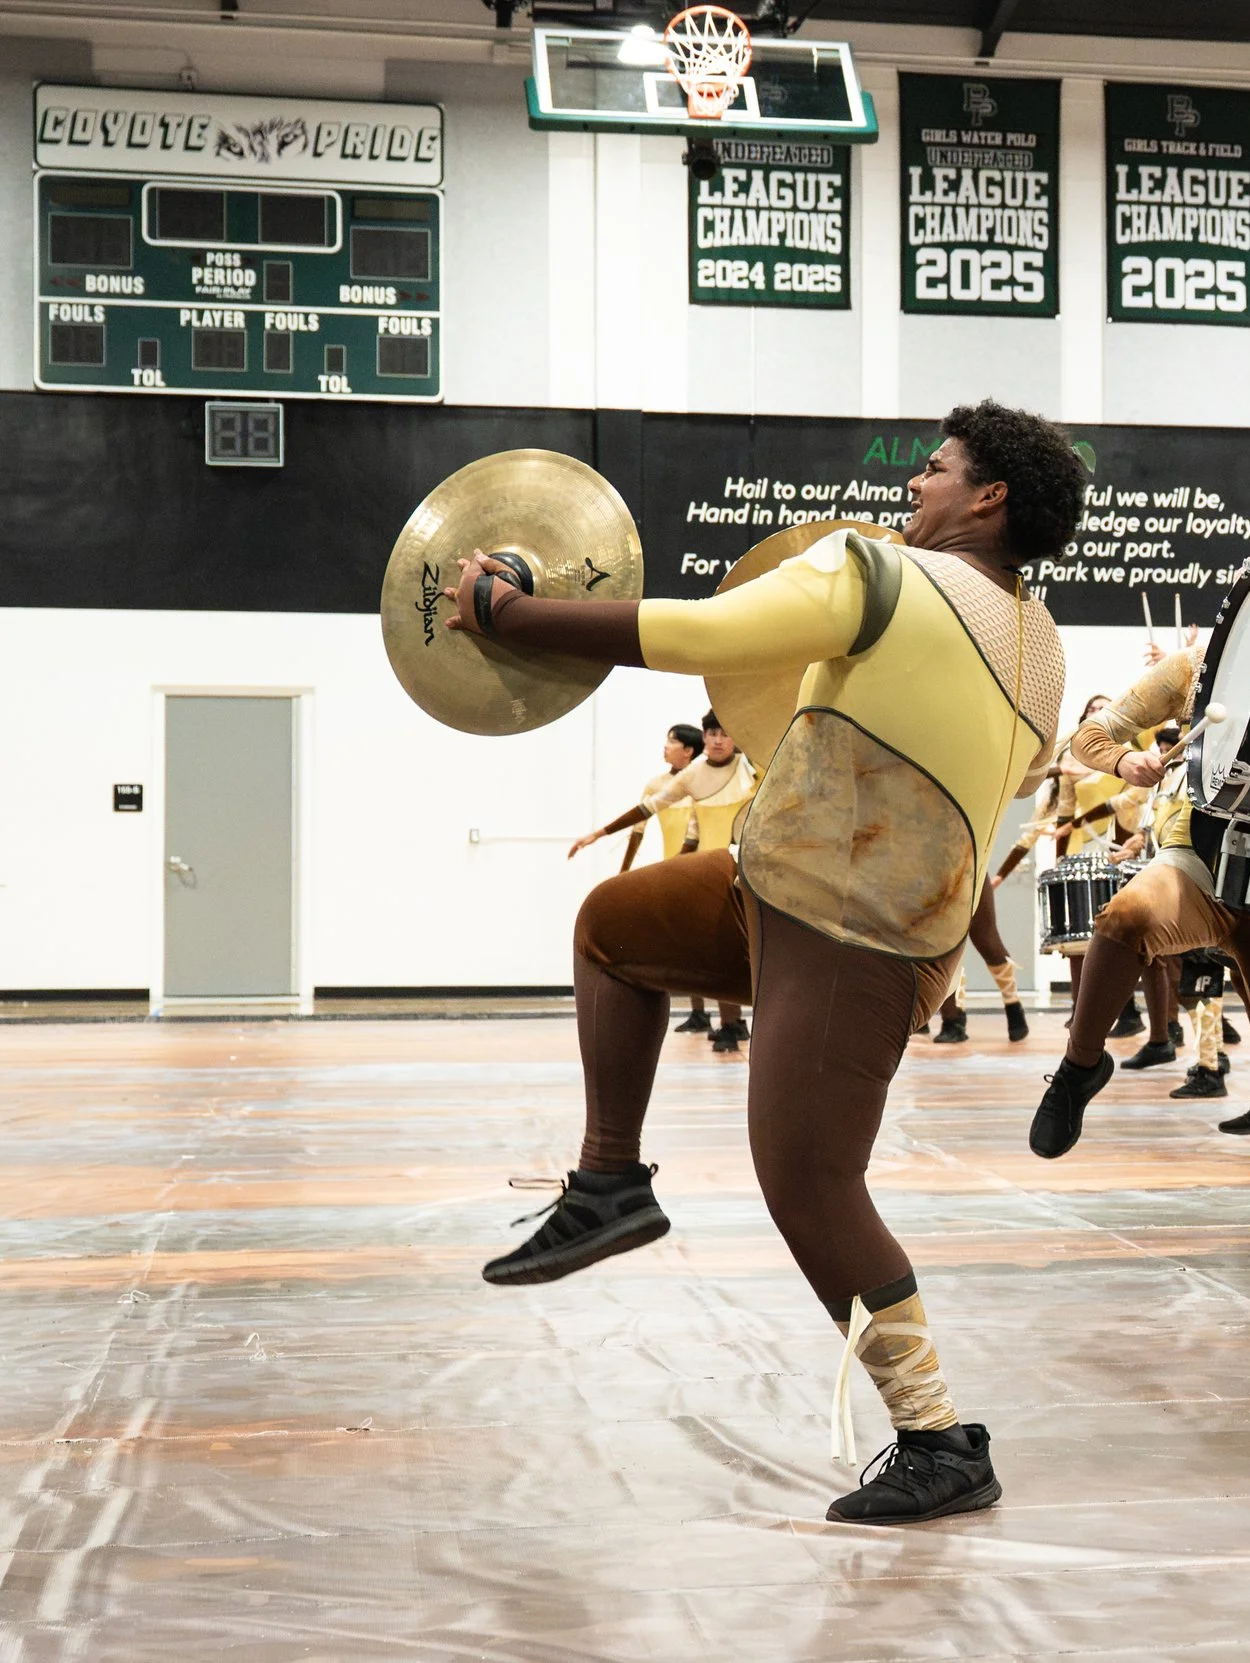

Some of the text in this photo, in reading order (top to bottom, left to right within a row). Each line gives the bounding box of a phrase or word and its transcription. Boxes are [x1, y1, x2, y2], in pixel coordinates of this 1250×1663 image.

[38, 107, 441, 162] COYOTE PRIDE
[921, 128, 1037, 147] GIRLS WATER POLO
[714, 138, 833, 167] NDEFEATED
[1124, 138, 1158, 153] GIRLS
[1160, 140, 1197, 156] TRACK
[1208, 143, 1242, 158] FIELD
[697, 168, 842, 211] LEAGUE
[908, 166, 1049, 209] LEAGUE
[1116, 164, 1250, 208] LEAGUE
[697, 207, 842, 255] CHAMPIONS
[908, 205, 1049, 250] CHAMPIONS
[1116, 204, 1250, 251] CHAMPIONS
[206, 252, 241, 267] POSS
[85, 275, 144, 295] BONUS
[192, 266, 256, 287] PERIOD
[697, 259, 842, 293] 2024 2025
[915, 247, 1045, 303] 2025
[1121, 256, 1247, 312] 2025
[339, 285, 397, 305] BONUS
[49, 304, 105, 323] FOULS
[180, 309, 246, 328] PLAYER
[264, 312, 319, 332] FOULS
[378, 316, 432, 336] FOULS
[131, 368, 165, 388] TOL
[318, 375, 352, 394] TOL
[724, 477, 768, 500] Hail
[773, 480, 796, 501] to
[801, 483, 841, 501] our
[843, 479, 902, 502] Alma
[1116, 491, 1148, 508] we
[1153, 486, 1190, 508] will
[1193, 487, 1225, 512] be,
[686, 501, 750, 524] Hand
[752, 504, 773, 525] in
[778, 504, 836, 525] hand
[840, 510, 874, 522] we
[1144, 517, 1182, 534] our
[1083, 541, 1121, 557] our
[1123, 540, 1175, 562] part.
[680, 553, 720, 575] For
[1038, 560, 1088, 583] Park
[1093, 566, 1128, 583] we
[1128, 563, 1211, 589] proudly
[415, 560, 444, 647] Zildjian
